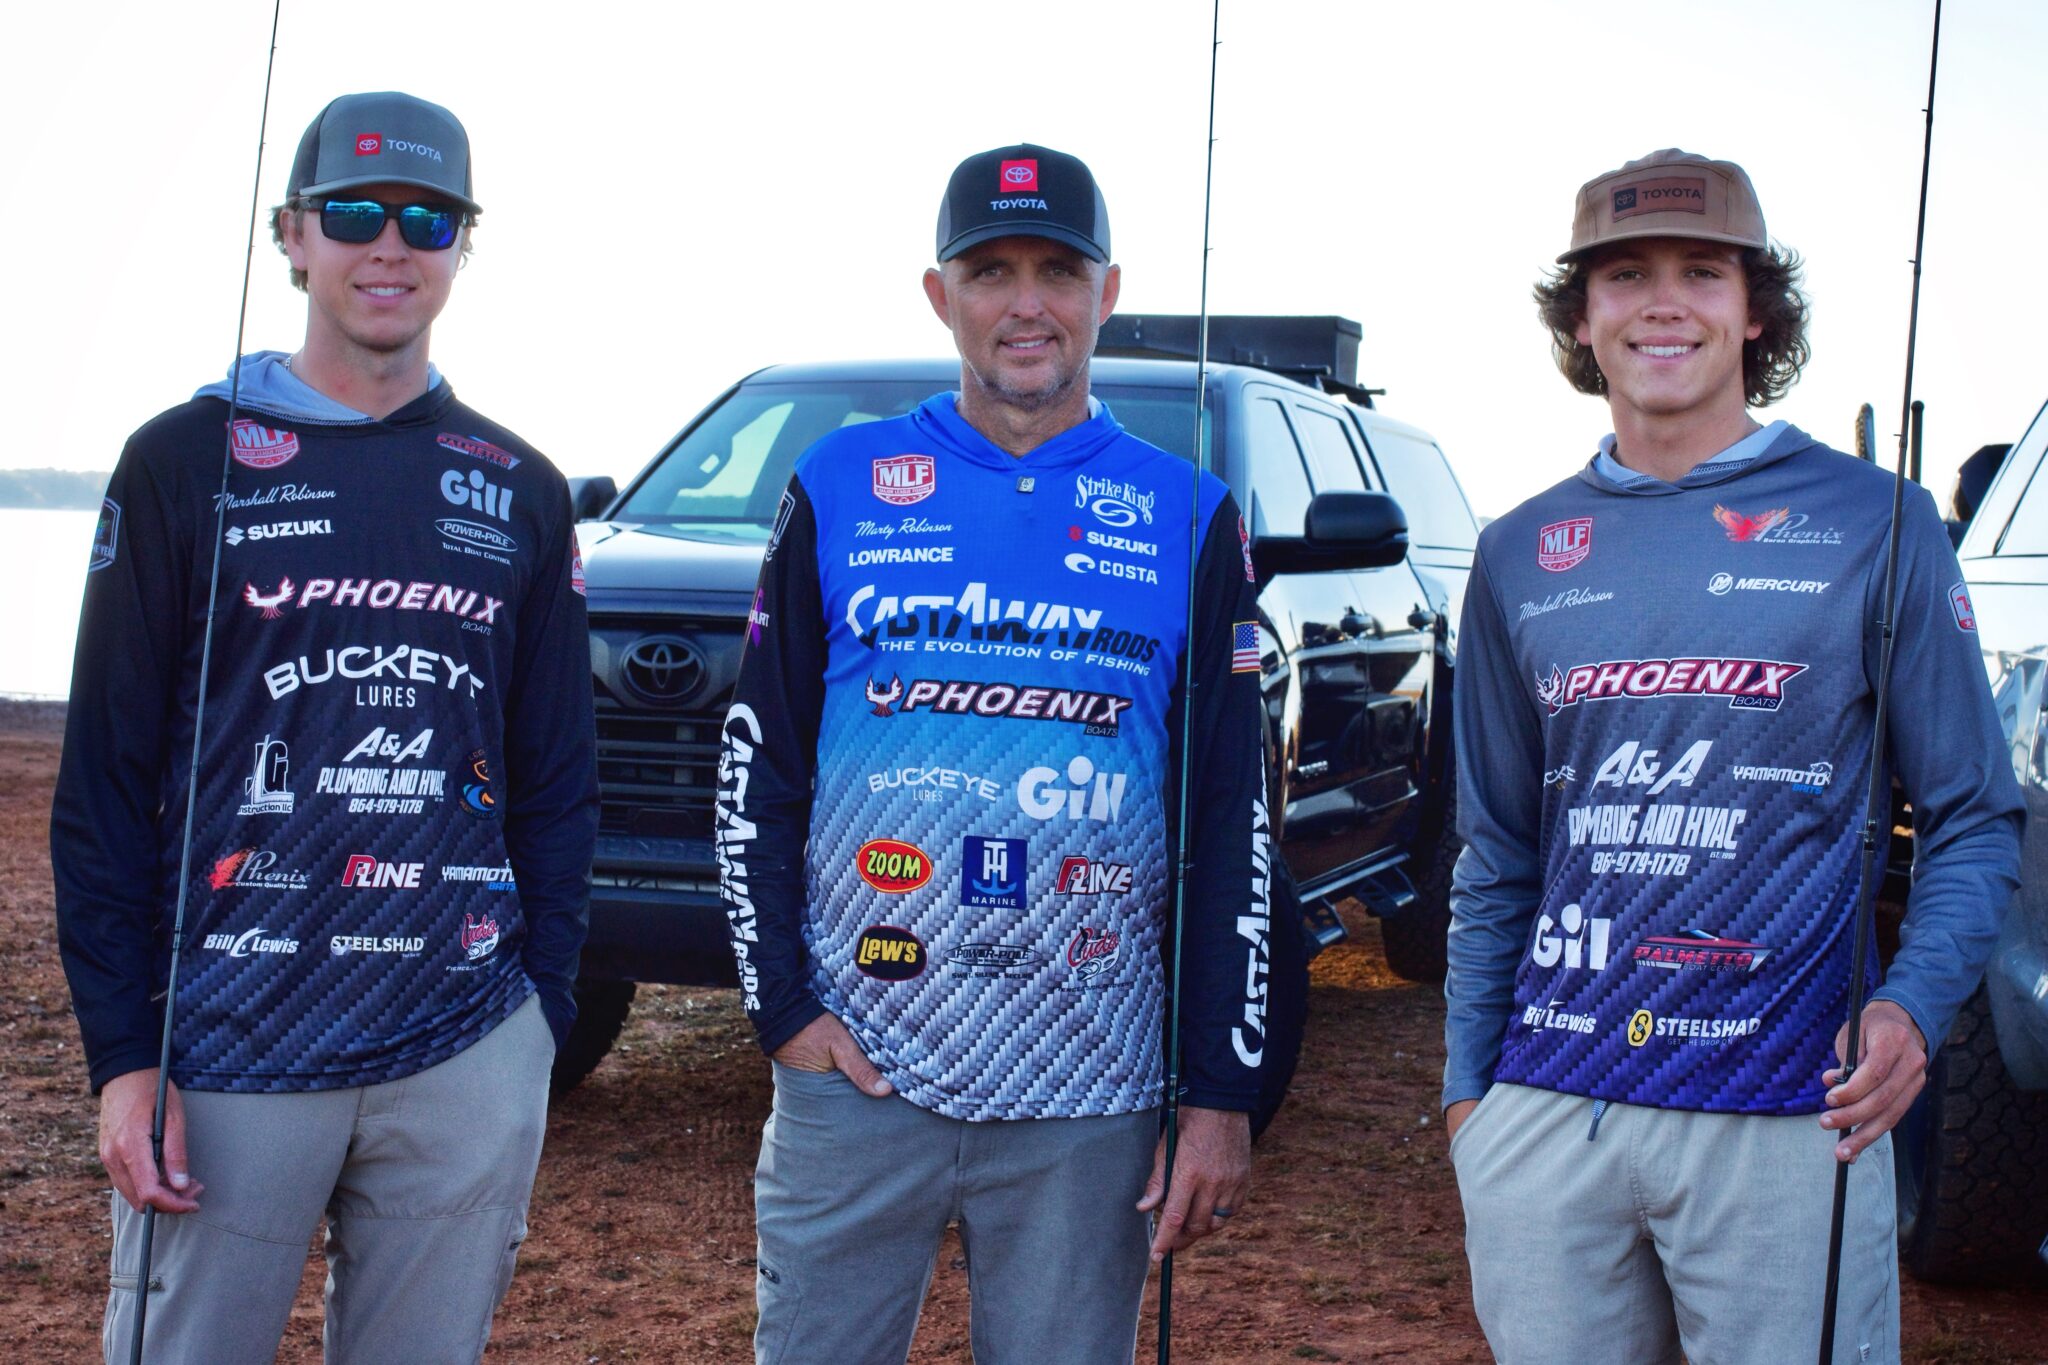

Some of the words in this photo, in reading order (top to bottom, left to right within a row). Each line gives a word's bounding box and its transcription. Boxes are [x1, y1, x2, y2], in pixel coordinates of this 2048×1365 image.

[387, 139, 442, 163] TOYOTA
[990, 198, 1048, 211] TOYOTA
[1642, 187, 1702, 200] TOYOTA
[235, 425, 289, 449] MLF
[879, 464, 929, 488] MLF
[213, 486, 279, 512] Marshall
[279, 483, 336, 503] Robinson
[440, 469, 513, 522] Gill
[1075, 474, 1122, 509] Strike
[1121, 483, 1155, 525] King
[247, 519, 331, 541] SUZUKI
[443, 522, 509, 548] POWER-POLE
[855, 520, 895, 540] Marty
[897, 517, 953, 534] Robinson
[1543, 526, 1586, 554] MLF
[1754, 513, 1845, 542] Phenix
[1086, 531, 1158, 557] SUZUKI
[848, 547, 954, 567] LOWRANCE
[1099, 559, 1158, 585] COSTA
[1735, 578, 1831, 594] MERCURY
[297, 578, 503, 625] PHOENIX
[1520, 592, 1564, 622] Mitchell
[1562, 586, 1615, 608] Robinson
[461, 620, 492, 636] BOATS
[879, 640, 915, 652] THE
[924, 641, 1041, 660] EVOLUTION
[1050, 649, 1079, 661] OF
[1085, 654, 1151, 677] FISHING
[1564, 660, 1802, 704] PHOENIX
[356, 685, 416, 708] LURES
[903, 681, 1132, 726] PHOENIX
[1734, 696, 1778, 709] BOATS
[1085, 725, 1118, 737] BOATS
[341, 727, 434, 763] A&A
[1588, 739, 1714, 797] A&A
[1732, 765, 1828, 786] YAMAMOTO
[316, 767, 389, 794] PLUMBING
[387, 768, 419, 795] AND
[868, 766, 1001, 801] BUCKEYE
[1017, 755, 1127, 825] Gill
[348, 798, 424, 814] 864-979-1178
[913, 789, 943, 801] LURES
[239, 803, 281, 814] nstruction
[1637, 804, 1686, 846] AND
[1680, 806, 1747, 850] HVAC
[235, 850, 311, 883] Phenix
[866, 850, 921, 879] ZOOM
[1591, 851, 1692, 876] 86-979-1178
[971, 896, 1017, 906] MARINE
[203, 934, 236, 950] Bill
[251, 936, 299, 954] Lewis
[331, 936, 424, 952] STEELSHAD
[956, 949, 1030, 960] POWER-POLE
[1066, 926, 1118, 968] Cuda
[1633, 946, 1754, 967] PALMETTO
[1545, 1008, 1597, 1034] Lewis
[1656, 1018, 1761, 1038] STEELSHAD
